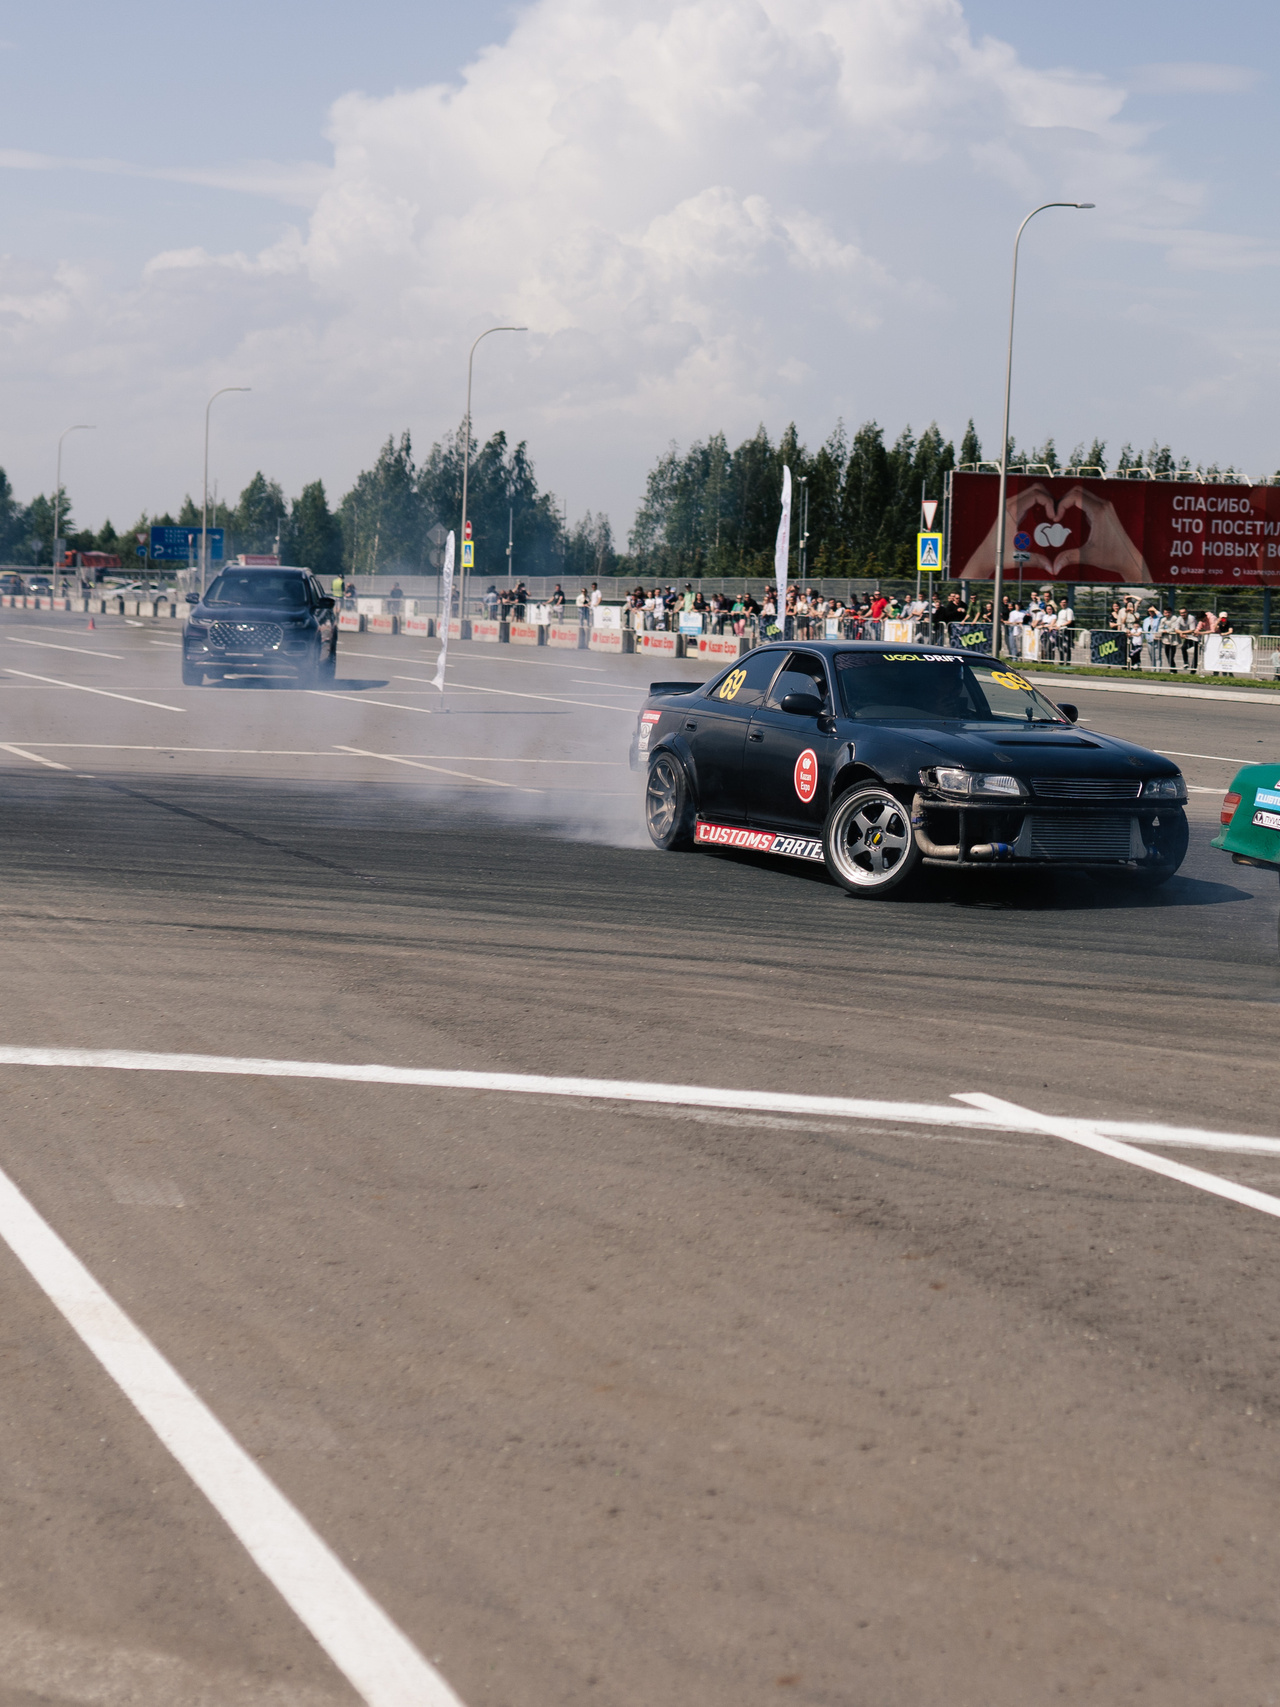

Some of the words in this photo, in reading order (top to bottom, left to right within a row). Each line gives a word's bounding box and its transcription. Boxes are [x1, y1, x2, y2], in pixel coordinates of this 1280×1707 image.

[1172, 496, 1254, 516] СПАСИБО,
[1171, 518, 1204, 534] ЧТО
[1170, 540, 1194, 557] ДО
[1202, 541, 1260, 558] НОВЫХ
[766, 624, 780, 636] UGO
[960, 631, 987, 647] UGOL
[708, 640, 723, 653] Kazan
[724, 641, 737, 655] Expo
[1098, 640, 1118, 657] UGOL
[719, 668, 747, 700] 69
[990, 671, 1033, 691] 69
[799, 771, 812, 782] Kazan
[800, 781, 811, 793] Expo
[699, 824, 774, 850] CUSTOMS
